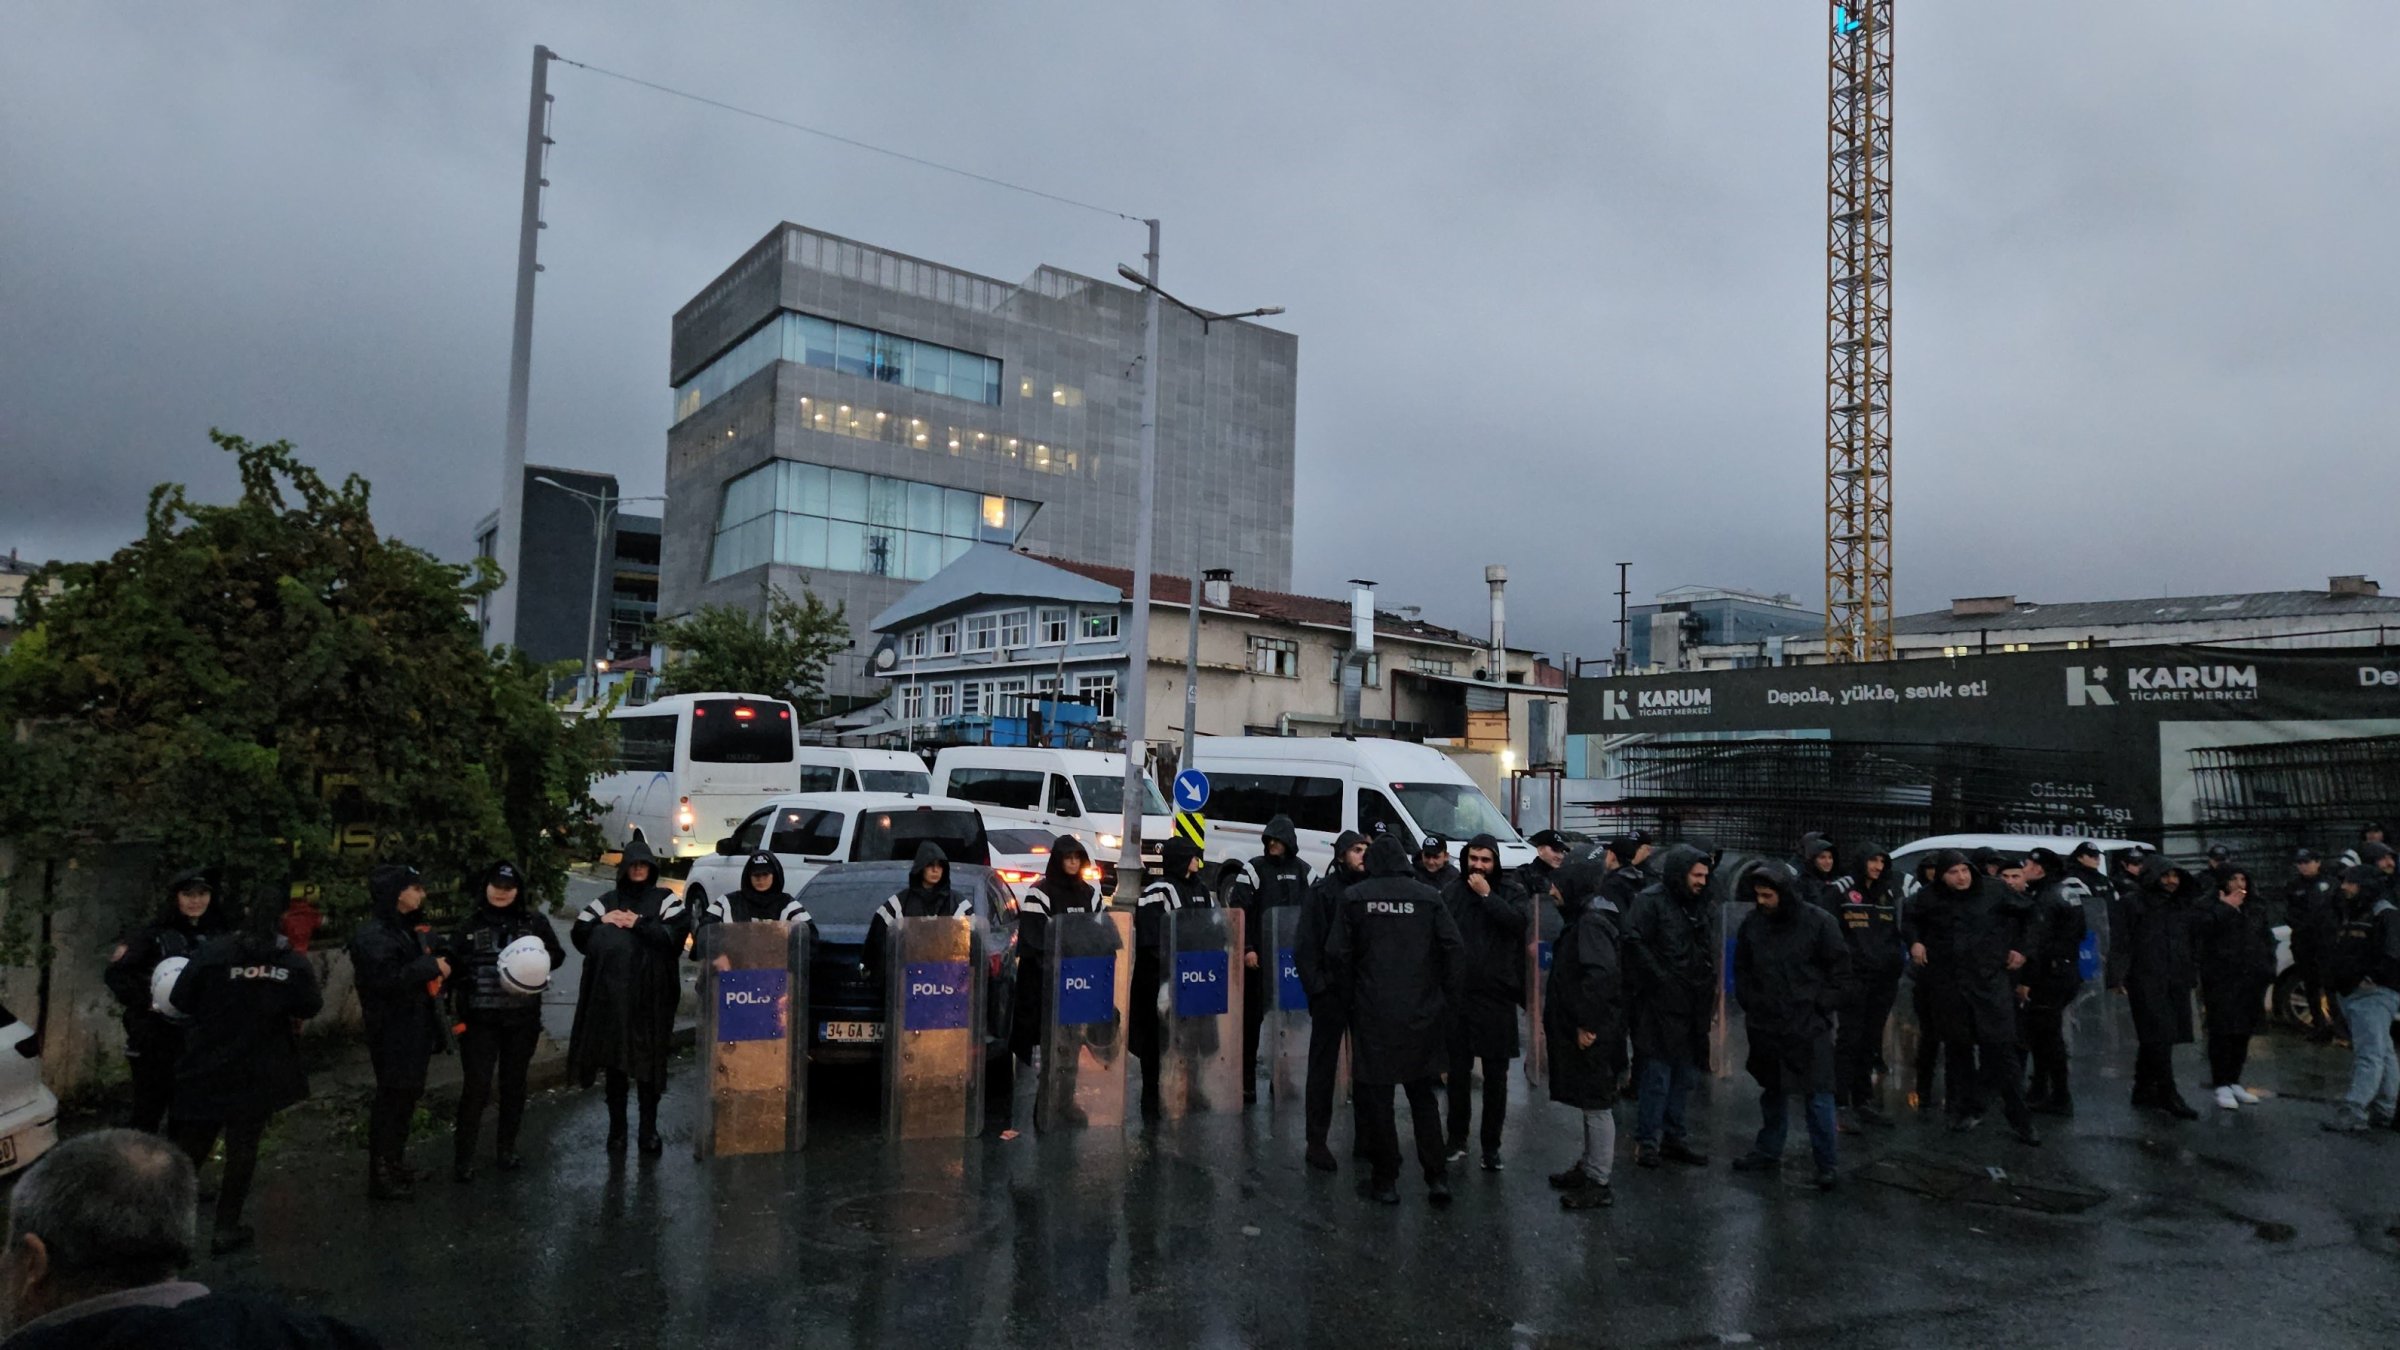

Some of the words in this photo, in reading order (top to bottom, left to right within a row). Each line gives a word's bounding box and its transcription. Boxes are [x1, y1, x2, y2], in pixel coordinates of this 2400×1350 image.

[2127, 665, 2257, 689] KARUM
[2359, 667, 2400, 686] De
[1638, 688, 1712, 707] KARUM
[1767, 686, 1834, 706] Depola,
[1840, 684, 1899, 705] yükle,
[1905, 681, 1952, 699] sevk
[1958, 680, 1988, 697] et!
[2129, 690, 2190, 702] TİCARET
[2194, 689, 2258, 701] MERKEZİ
[1639, 707, 1673, 717] TİCARET
[1674, 706, 1712, 716] MERKEZİ
[827, 1023, 842, 1038] 34
[848, 1023, 863, 1038] GA
